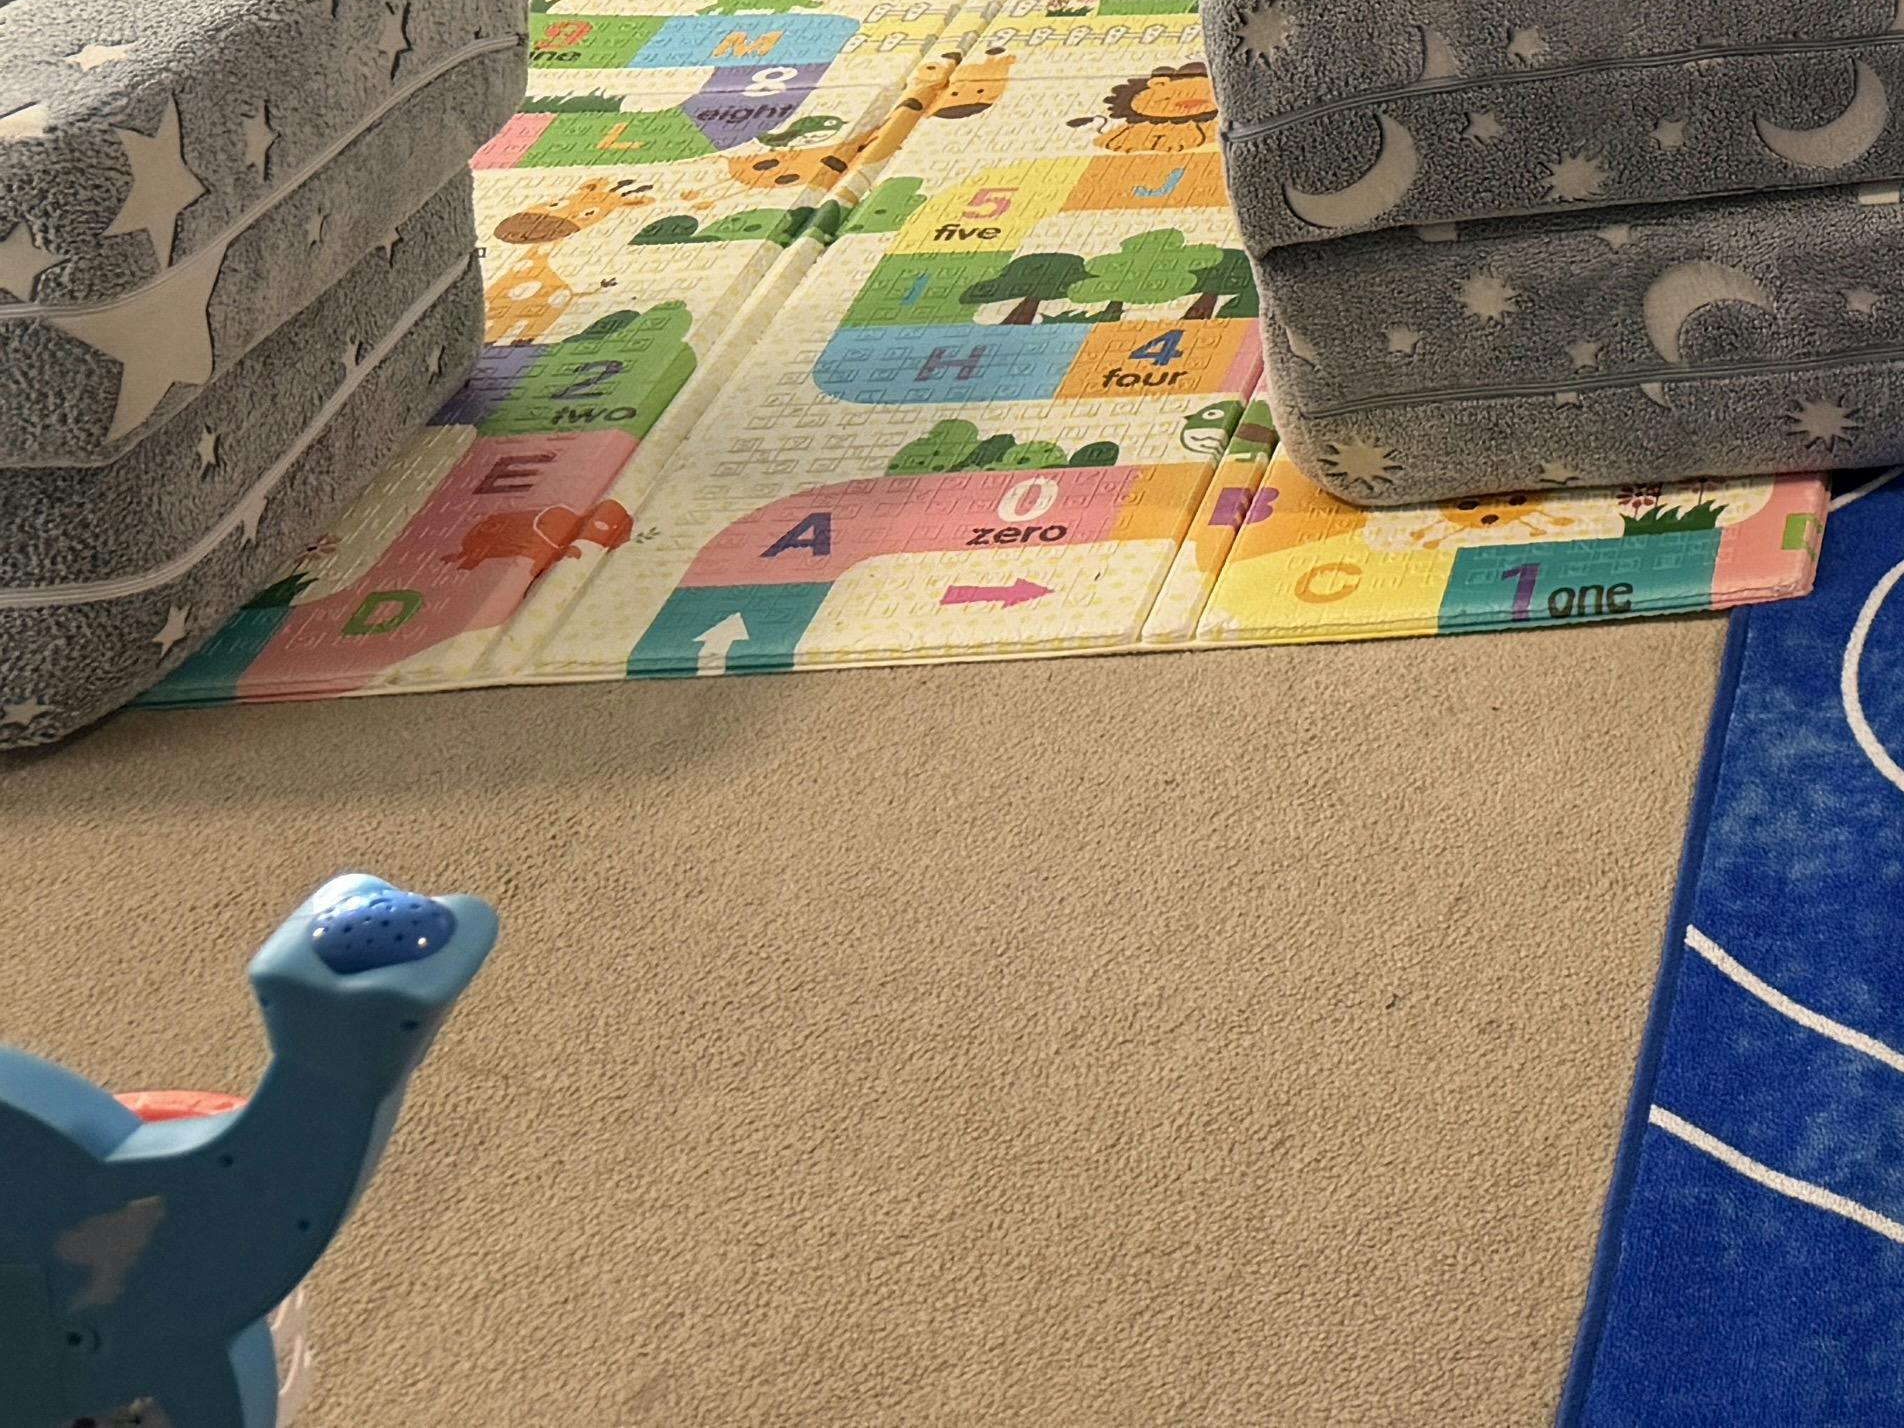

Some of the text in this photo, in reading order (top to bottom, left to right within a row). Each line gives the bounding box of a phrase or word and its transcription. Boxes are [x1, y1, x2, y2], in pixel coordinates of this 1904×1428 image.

[527, 47, 583, 64] ine
[714, 29, 785, 58] M
[742, 65, 799, 97] 8
[698, 101, 794, 127] eight
[595, 121, 643, 151] L
[1132, 167, 1186, 198] J
[961, 186, 1019, 221] 5
[933, 221, 1002, 243] five
[917, 345, 988, 383] H
[1128, 328, 1190, 366] 4
[551, 359, 626, 401] 2
[1102, 365, 1189, 390] four
[550, 405, 637, 425] two
[472, 451, 558, 495] E
[997, 473, 1059, 523] 0
[1206, 486, 1281, 528] B
[759, 511, 833, 559] A
[965, 522, 1069, 547] zero
[1293, 560, 1363, 605] C
[1499, 562, 1635, 623] 1 one
[340, 588, 424, 637] D
